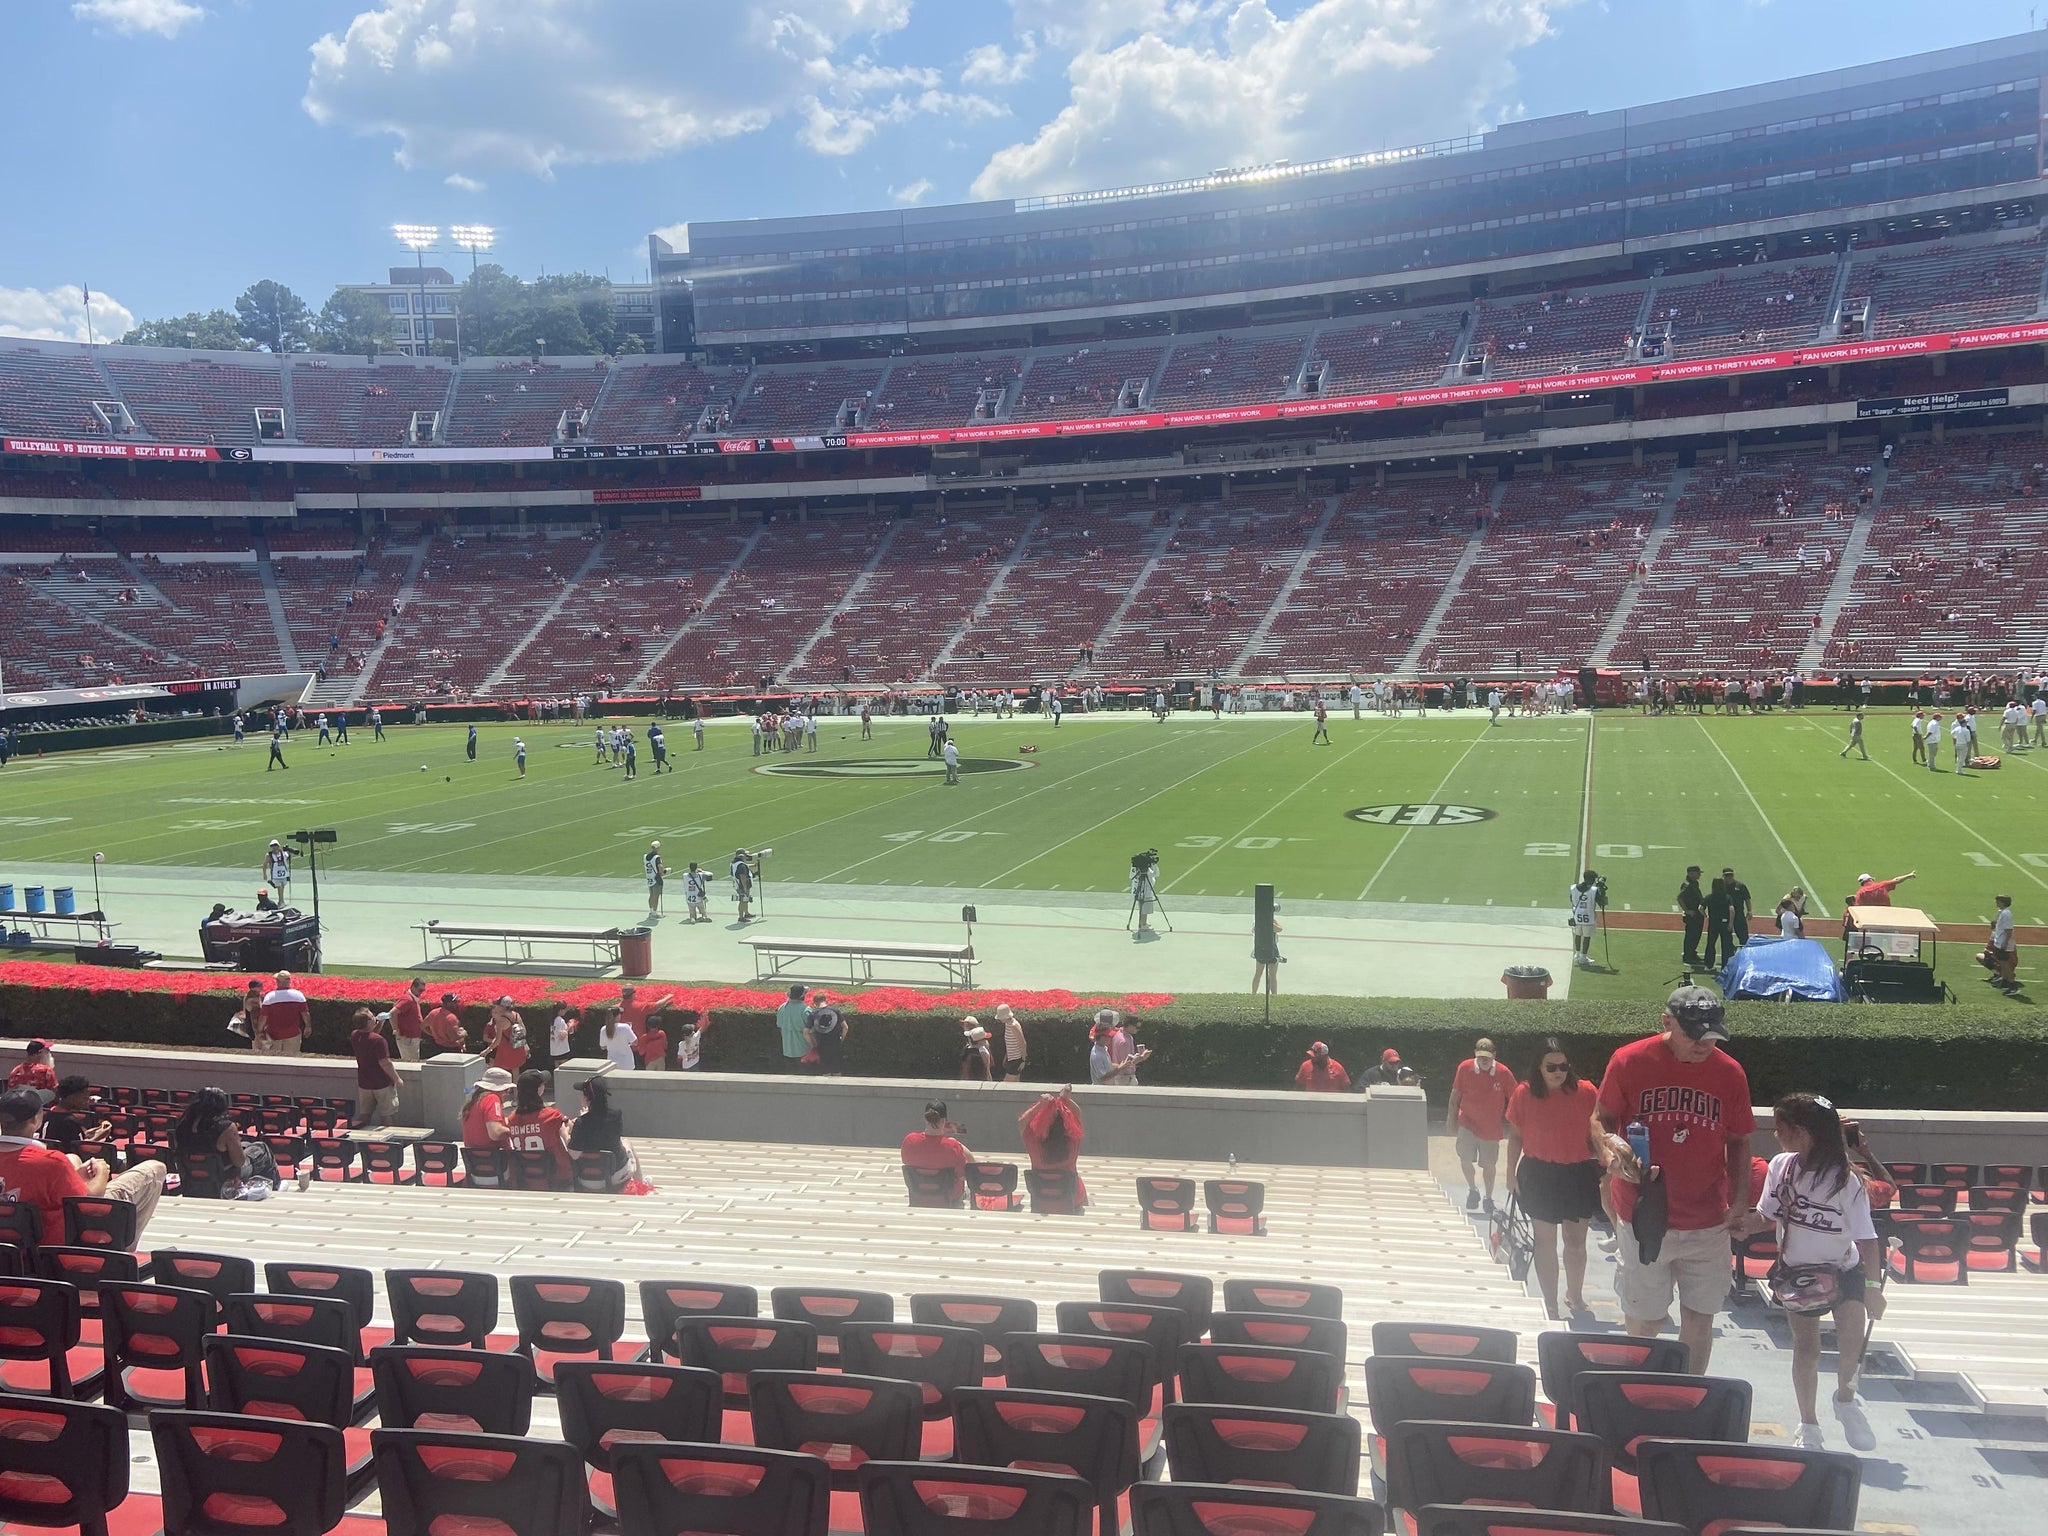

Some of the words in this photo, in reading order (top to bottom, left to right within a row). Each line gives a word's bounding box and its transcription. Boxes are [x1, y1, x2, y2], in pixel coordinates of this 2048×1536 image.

[1960, 335, 1979, 344] FAN
[1979, 332, 2010, 342] WORK
[2011, 330, 2021, 338] IS
[1802, 352, 1820, 362] FAN
[1820, 349, 1849, 360] WORK
[1849, 348, 1859, 356] IS
[1859, 344, 1898, 354] THIRSTY
[1898, 341, 1927, 350] WORK
[1660, 368, 1677, 376] FAN
[1677, 365, 1704, 374] WORK
[1704, 364, 1713, 372] IS
[1713, 360, 1749, 370] THIRSTY
[1749, 357, 1777, 366] WORK
[1527, 382, 1542, 390] FAN
[1543, 380, 1568, 388] WORK
[1576, 375, 1610, 386] THIRSTY
[1611, 373, 1637, 382] WORK
[1418, 393, 1441, 402] WORK
[1441, 392, 1449, 400] IS
[1449, 389, 1480, 398] THIRSTY
[1480, 387, 1504, 396] WORK
[1904, 397, 1929, 406] Need
[1932, 394, 1959, 404] Help?
[1284, 406, 1298, 414] FAN
[1298, 404, 1320, 412] WORK
[1327, 401, 1356, 410] THIRSTY
[1356, 399, 1379, 408] WORK
[1170, 416, 1184, 424] FAN
[1183, 414, 1204, 422] WORK
[1211, 411, 1239, 420] THIRSTY
[1239, 409, 1261, 418] WORK
[10, 440, 59, 452] VOLLEYBALL
[63, 444, 74, 453] VS
[77, 444, 103, 455] NOTRE
[104, 445, 127, 455] DAME
[178, 448, 189, 457] AT
[190, 448, 207, 458] 7PM
[826, 438, 846, 446] 70:00
[383, 451, 415, 459] Piedmont
[204, 683, 212, 691] IN
[213, 681, 237, 690] ATHENS
[1174, 835, 1282, 849] 30
[1523, 842, 1643, 858] 20
[1577, 914, 1590, 923] 56
[1640, 1085, 1722, 1123] GEORGIA
[1648, 1113, 1715, 1130] BULLDOGS
[510, 1124, 540, 1135] BOWERS
[1896, 1427, 1924, 1440] 15
